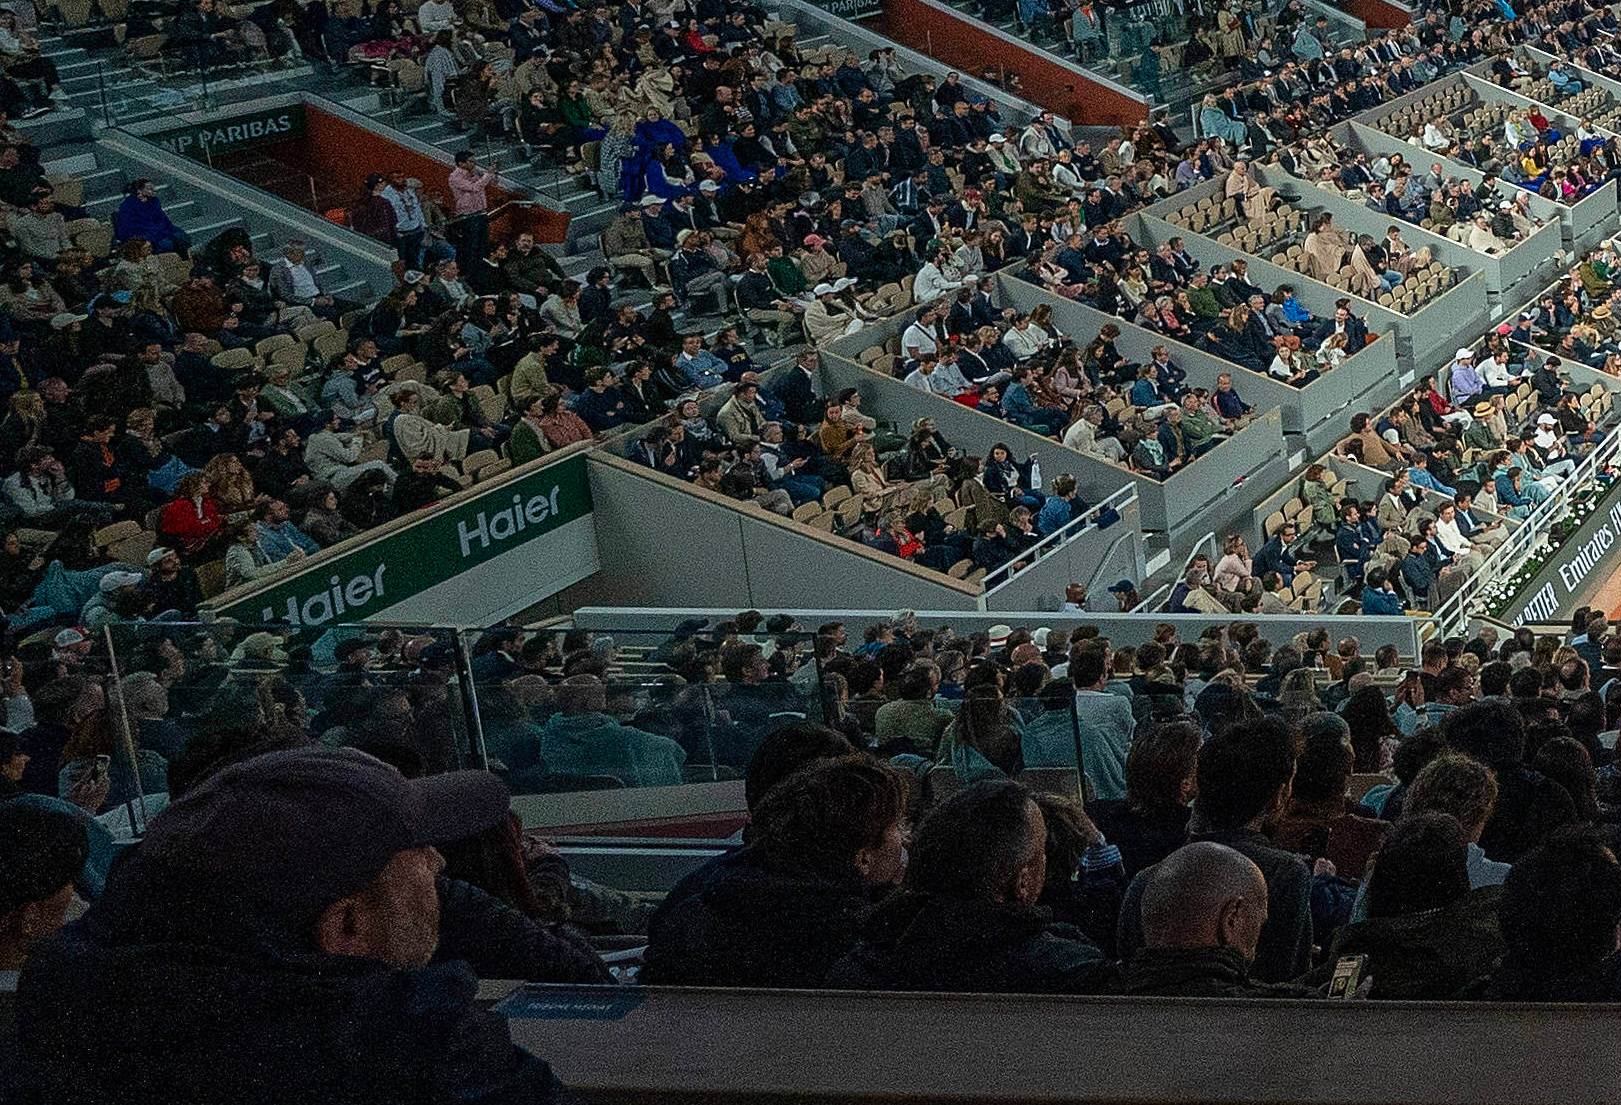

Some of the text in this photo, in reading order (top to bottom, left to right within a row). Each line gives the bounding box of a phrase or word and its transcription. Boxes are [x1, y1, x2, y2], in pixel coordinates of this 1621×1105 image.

[200, 115, 291, 149] PARIBAS
[457, 484, 560, 558] Haier
[1558, 523, 1614, 593] Emirates
